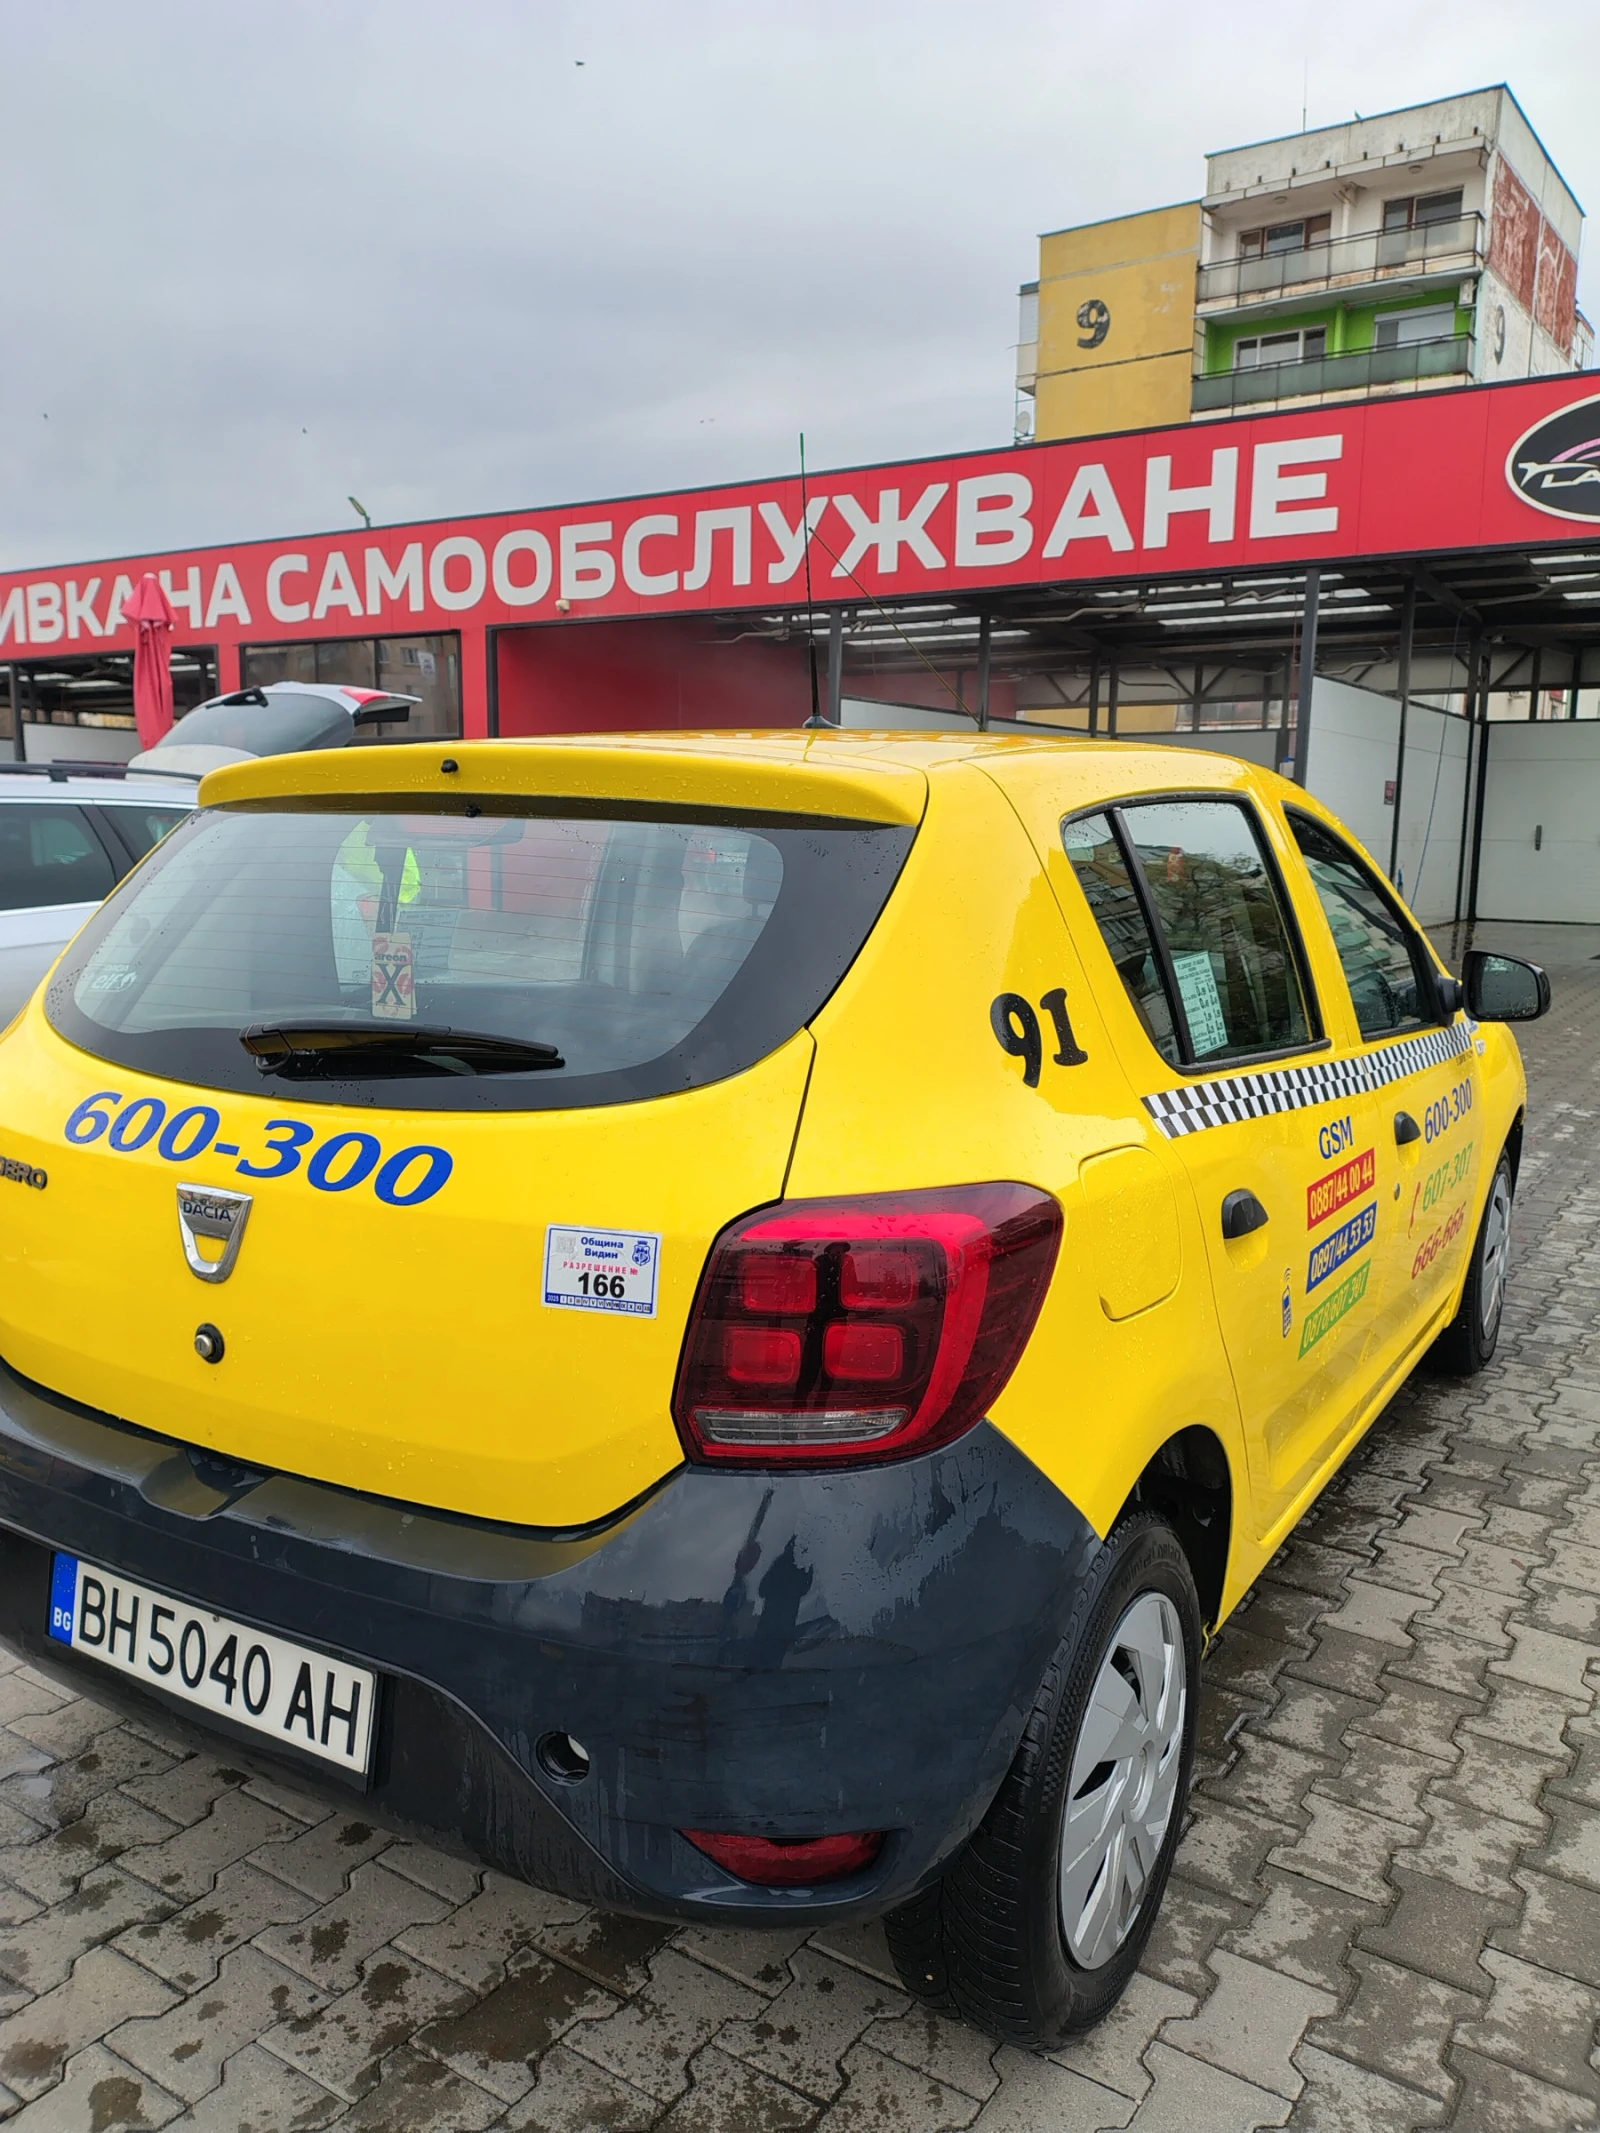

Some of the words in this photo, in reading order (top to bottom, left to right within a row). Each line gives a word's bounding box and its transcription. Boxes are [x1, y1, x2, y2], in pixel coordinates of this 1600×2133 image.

[1076, 298, 1110, 350] 9
[1494, 304, 1505, 365] 9
[158, 563, 252, 629] НА
[267, 433, 1343, 623] САМООБСЛУЖВАНЕ
[375, 963, 411, 1006] X
[990, 987, 1089, 1088] 91
[1318, 1115, 1353, 1159] GSM
[1424, 1078, 1472, 1144] 600-300
[64, 1091, 453, 1206] 600-300
[1422, 1141, 1474, 1212] 607-307
[183, 1200, 232, 1222] DACIA
[1310, 1170, 1348, 1220] 0887/44
[1349, 1163, 1361, 1194] 00
[1361, 1155, 1373, 1185] 44
[563, 1261, 627, 1275] РАЗРЕШЕНИЕ
[581, 1236, 624, 1249] Община
[584, 1248, 618, 1259] Видин
[1311, 1228, 1349, 1282] 0897/44
[1349, 1218, 1362, 1250] 53
[1361, 1209, 1374, 1240] 53
[1411, 1201, 1467, 1280] 666-666
[578, 1272, 625, 1299] 166
[54, 1606, 71, 1631] BG
[148, 1603, 272, 1716] 5040
